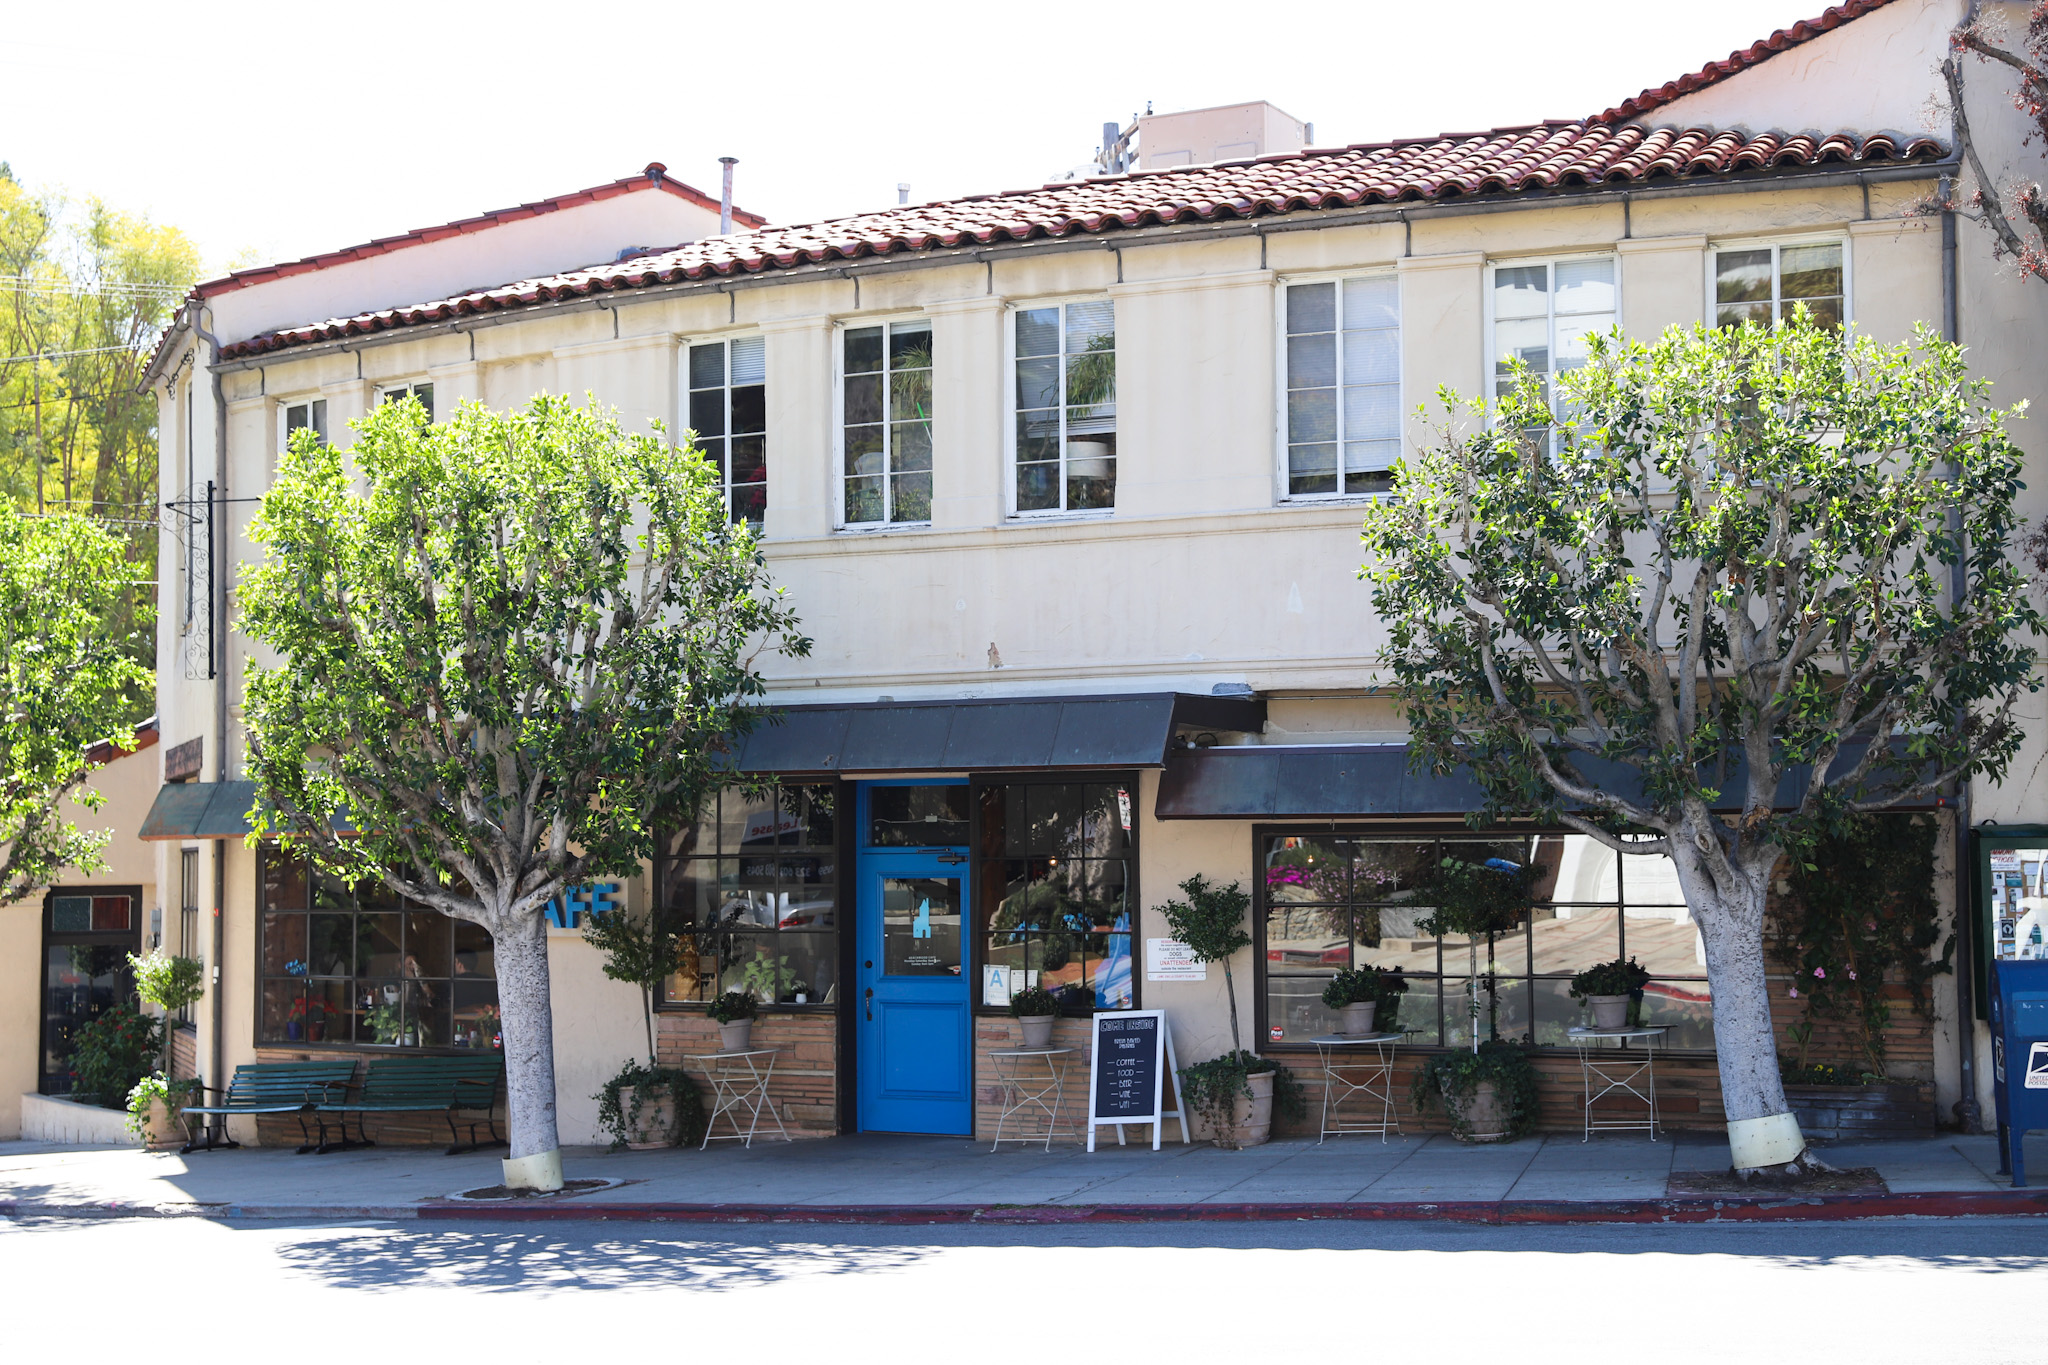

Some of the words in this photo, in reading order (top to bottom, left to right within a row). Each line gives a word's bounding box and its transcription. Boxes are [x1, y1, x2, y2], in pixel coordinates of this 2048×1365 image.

[543, 883, 619, 929] AFE
[990, 970, 1003, 987] A
[1100, 1020, 1124, 1031] COME
[1127, 1019, 1154, 1030] INSIDE
